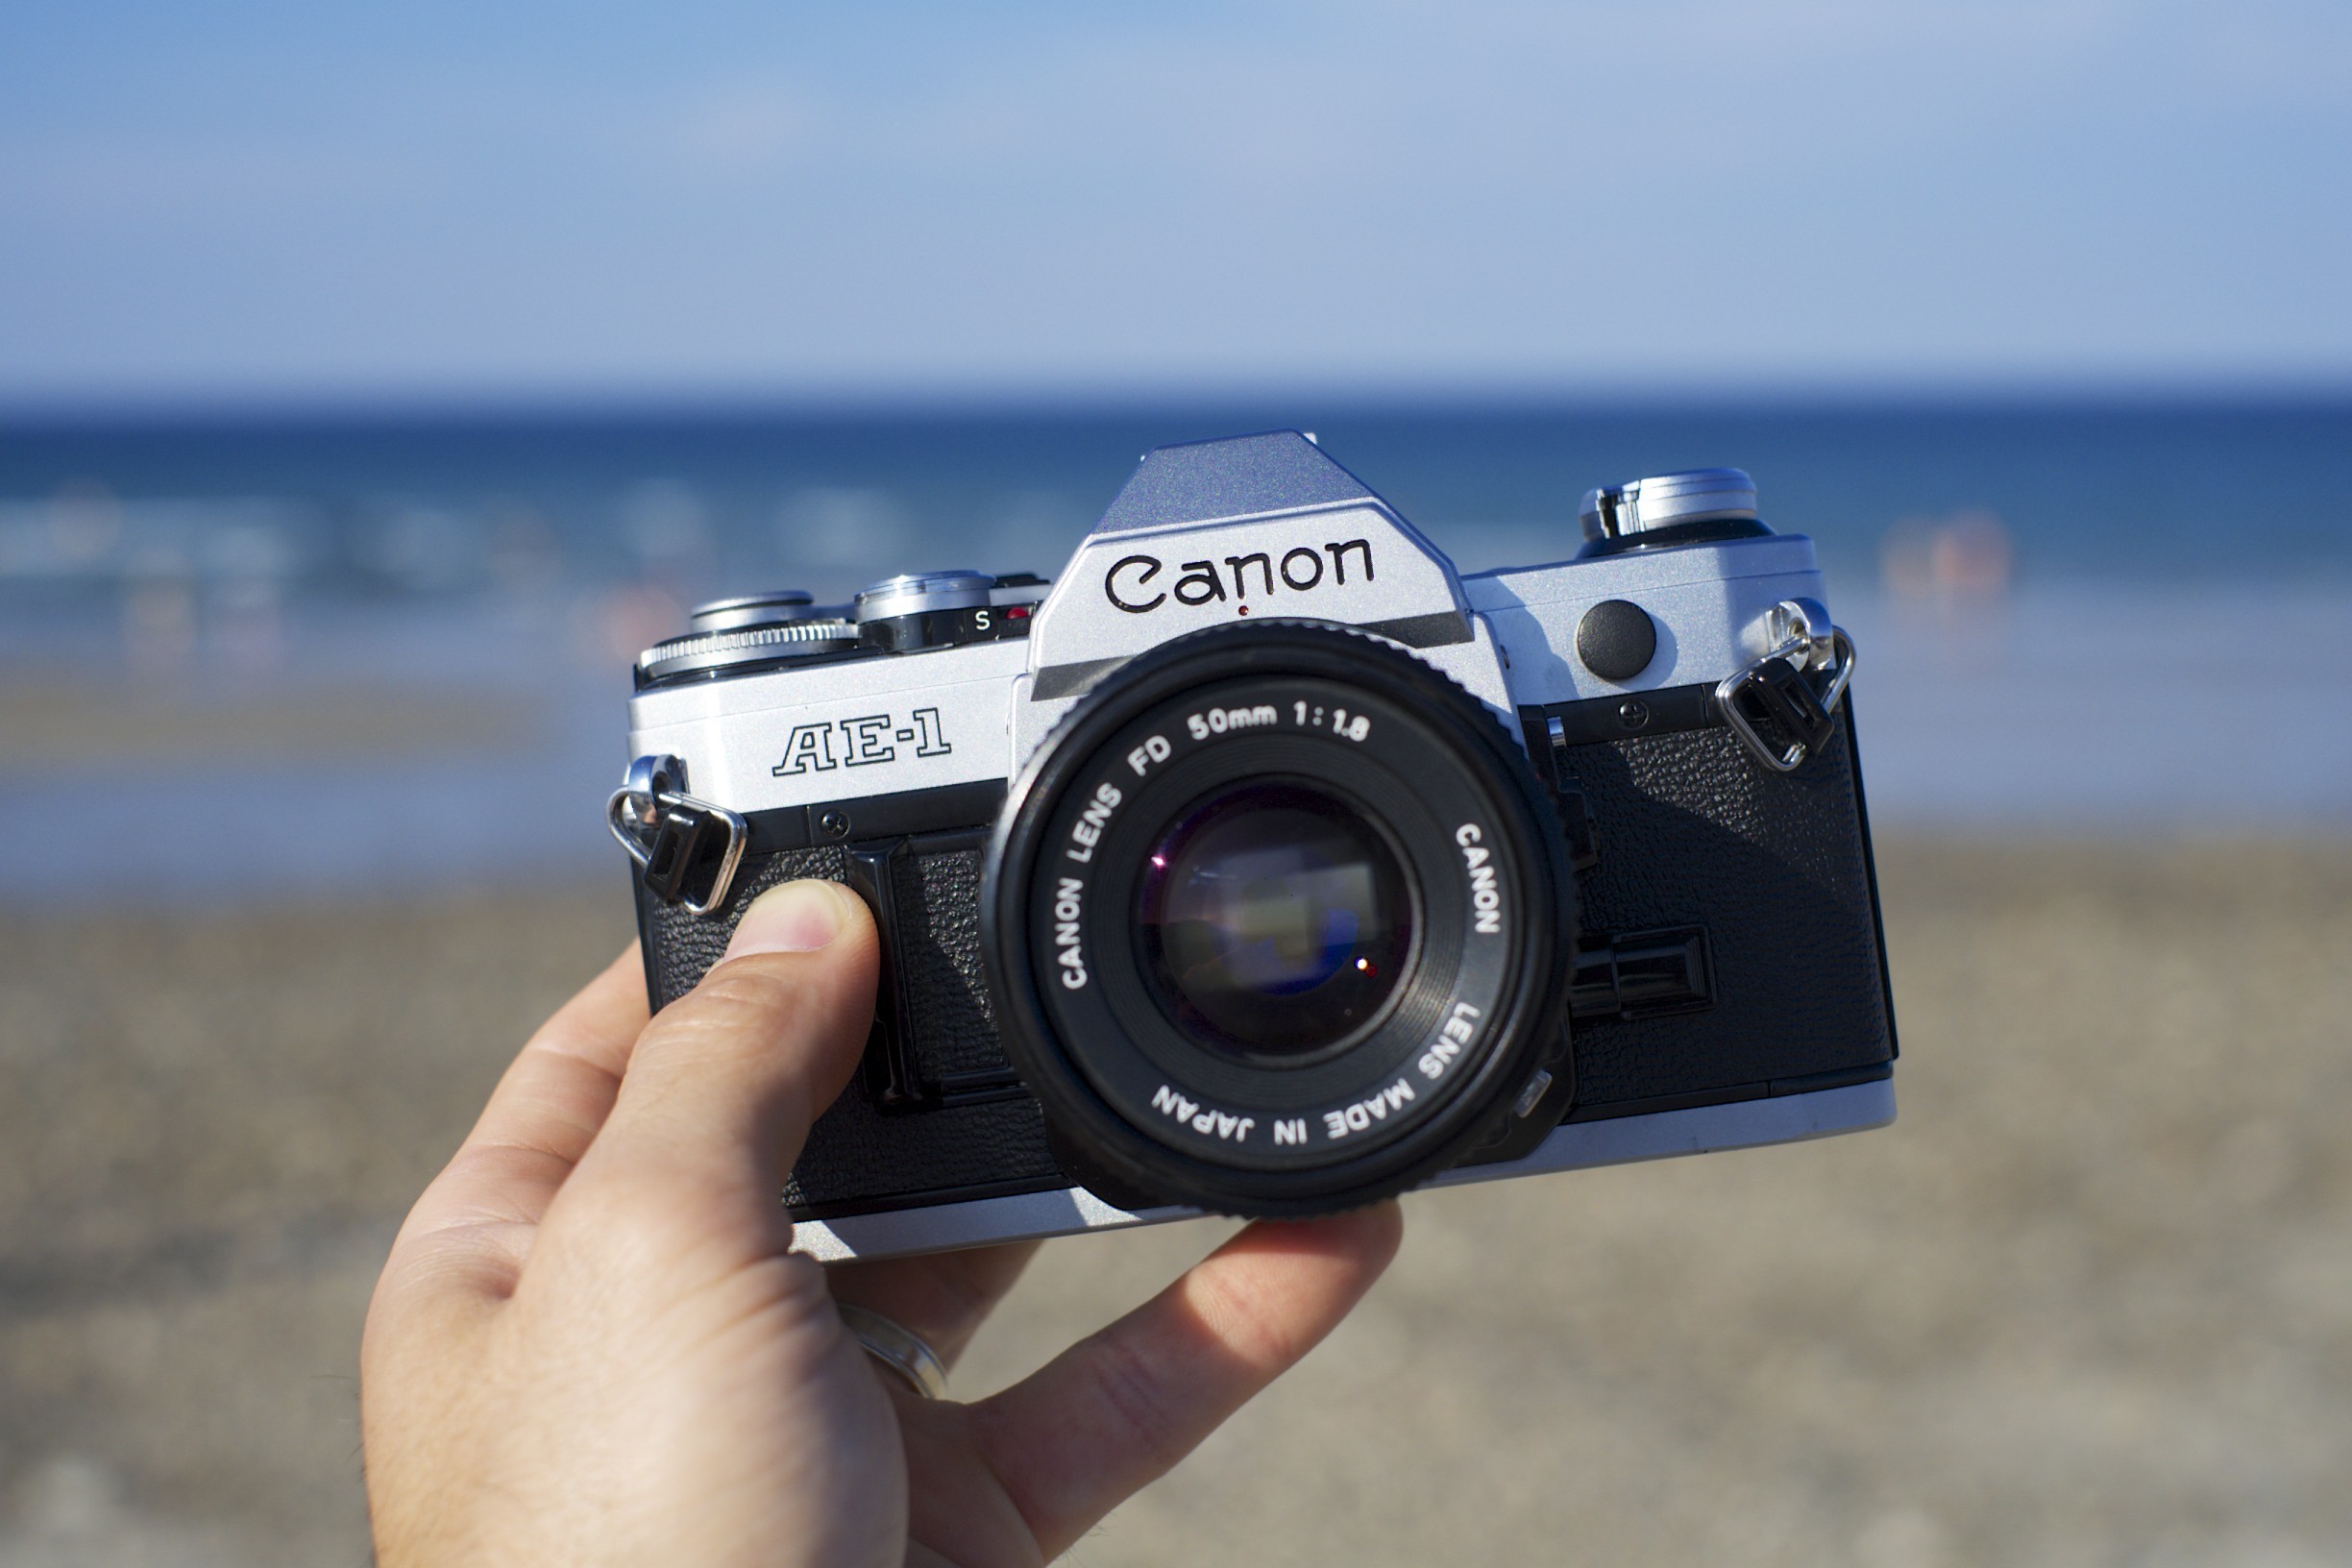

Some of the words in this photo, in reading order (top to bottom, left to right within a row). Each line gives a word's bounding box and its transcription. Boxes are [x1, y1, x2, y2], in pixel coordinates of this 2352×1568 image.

[1104, 538, 1375, 614] Canon
[974, 609, 992, 631] S
[772, 706, 952, 777] AE-1
[1126, 734, 1172, 777] FD
[1187, 704, 1278, 741] 50mm
[1066, 782, 1123, 864] LENS
[1455, 822, 1501, 934] CANON
[1054, 877, 1087, 991] CANON
[1418, 1001, 1482, 1080] LENS
[1151, 1085, 1256, 1142] JAPAN
[1273, 1117, 1308, 1145] IN
[1322, 1078, 1416, 1139] MADE
